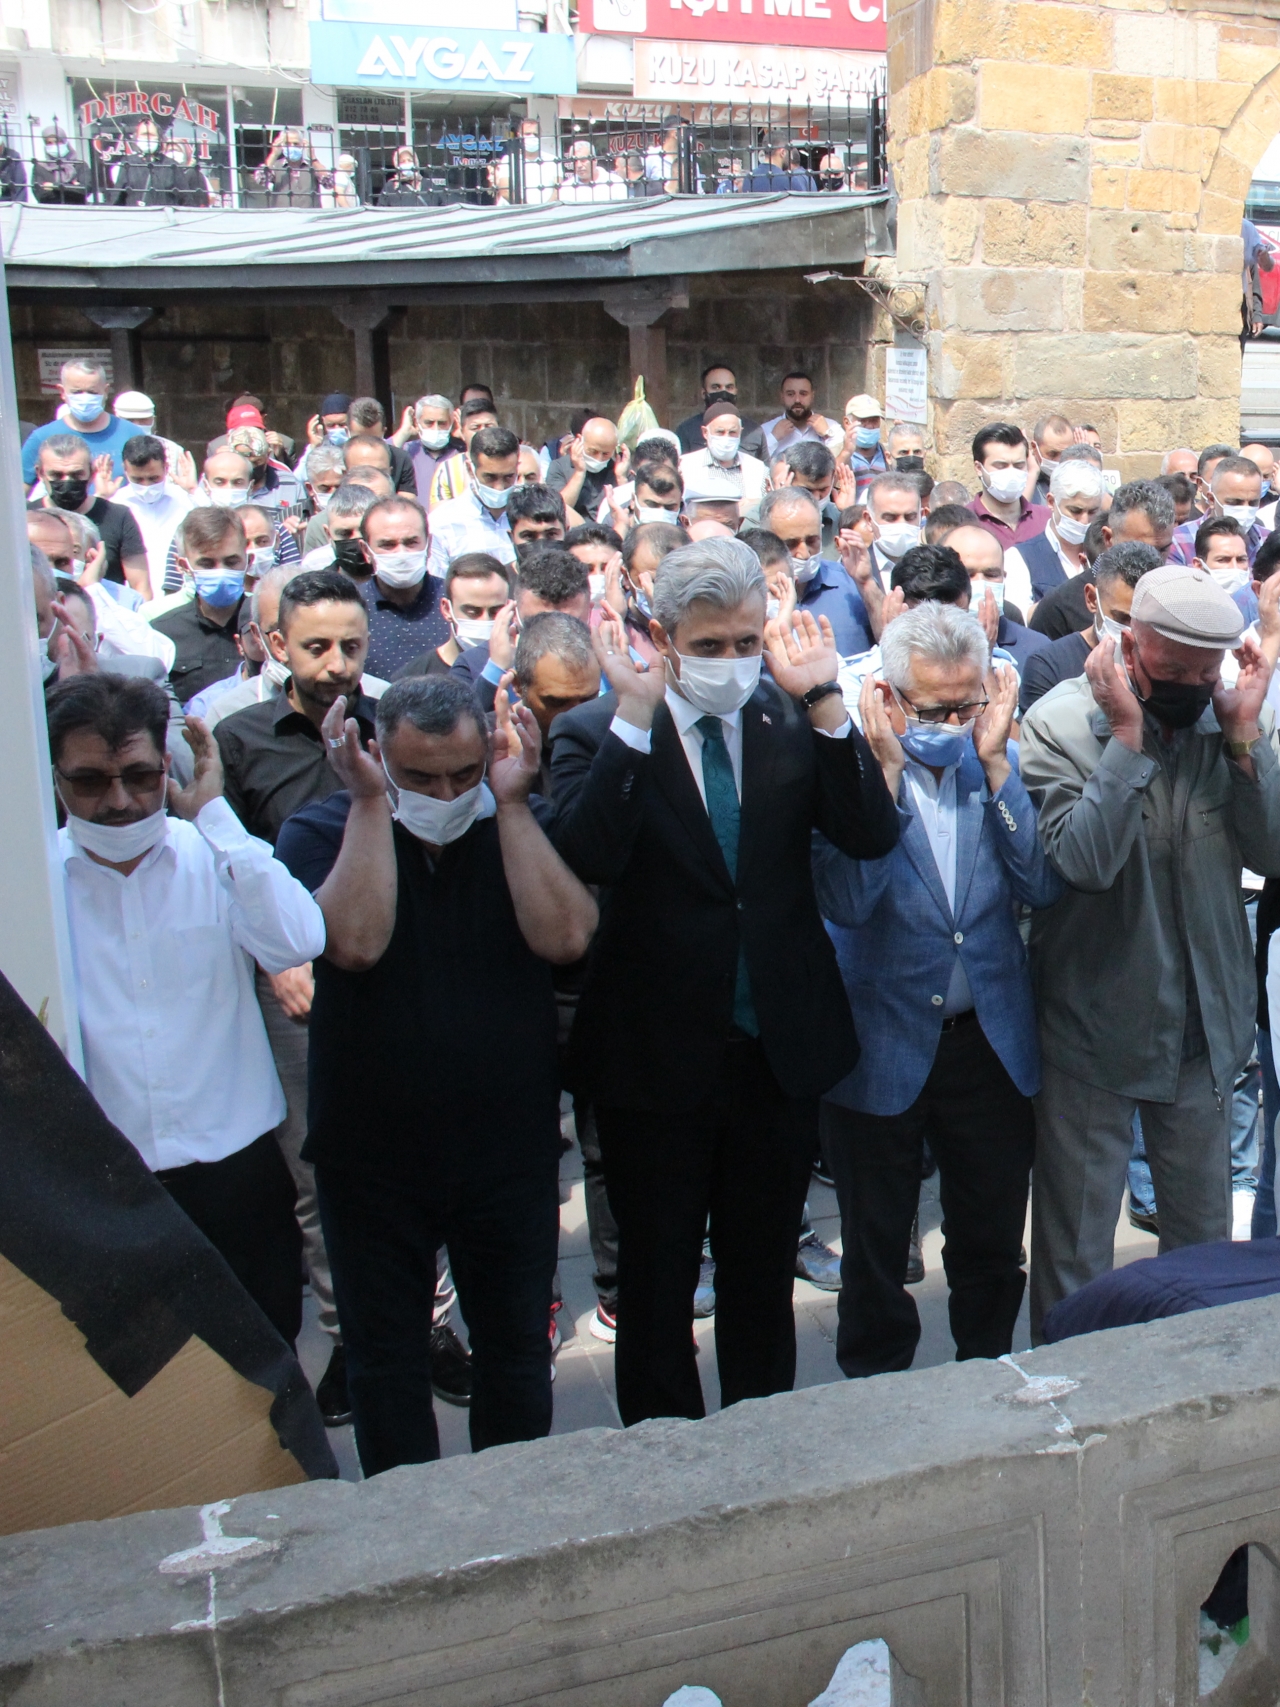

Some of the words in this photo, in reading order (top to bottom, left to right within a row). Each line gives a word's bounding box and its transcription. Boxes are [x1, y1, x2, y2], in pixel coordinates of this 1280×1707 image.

[356, 34, 535, 82] AYGAZ
[649, 54, 715, 85] KUZU
[724, 58, 806, 89] KASAP
[80, 91, 220, 133] DERGAH
[604, 102, 672, 118] KUZU
[699, 106, 780, 123] KASAP
[436, 134, 504, 151] AYGAZ
